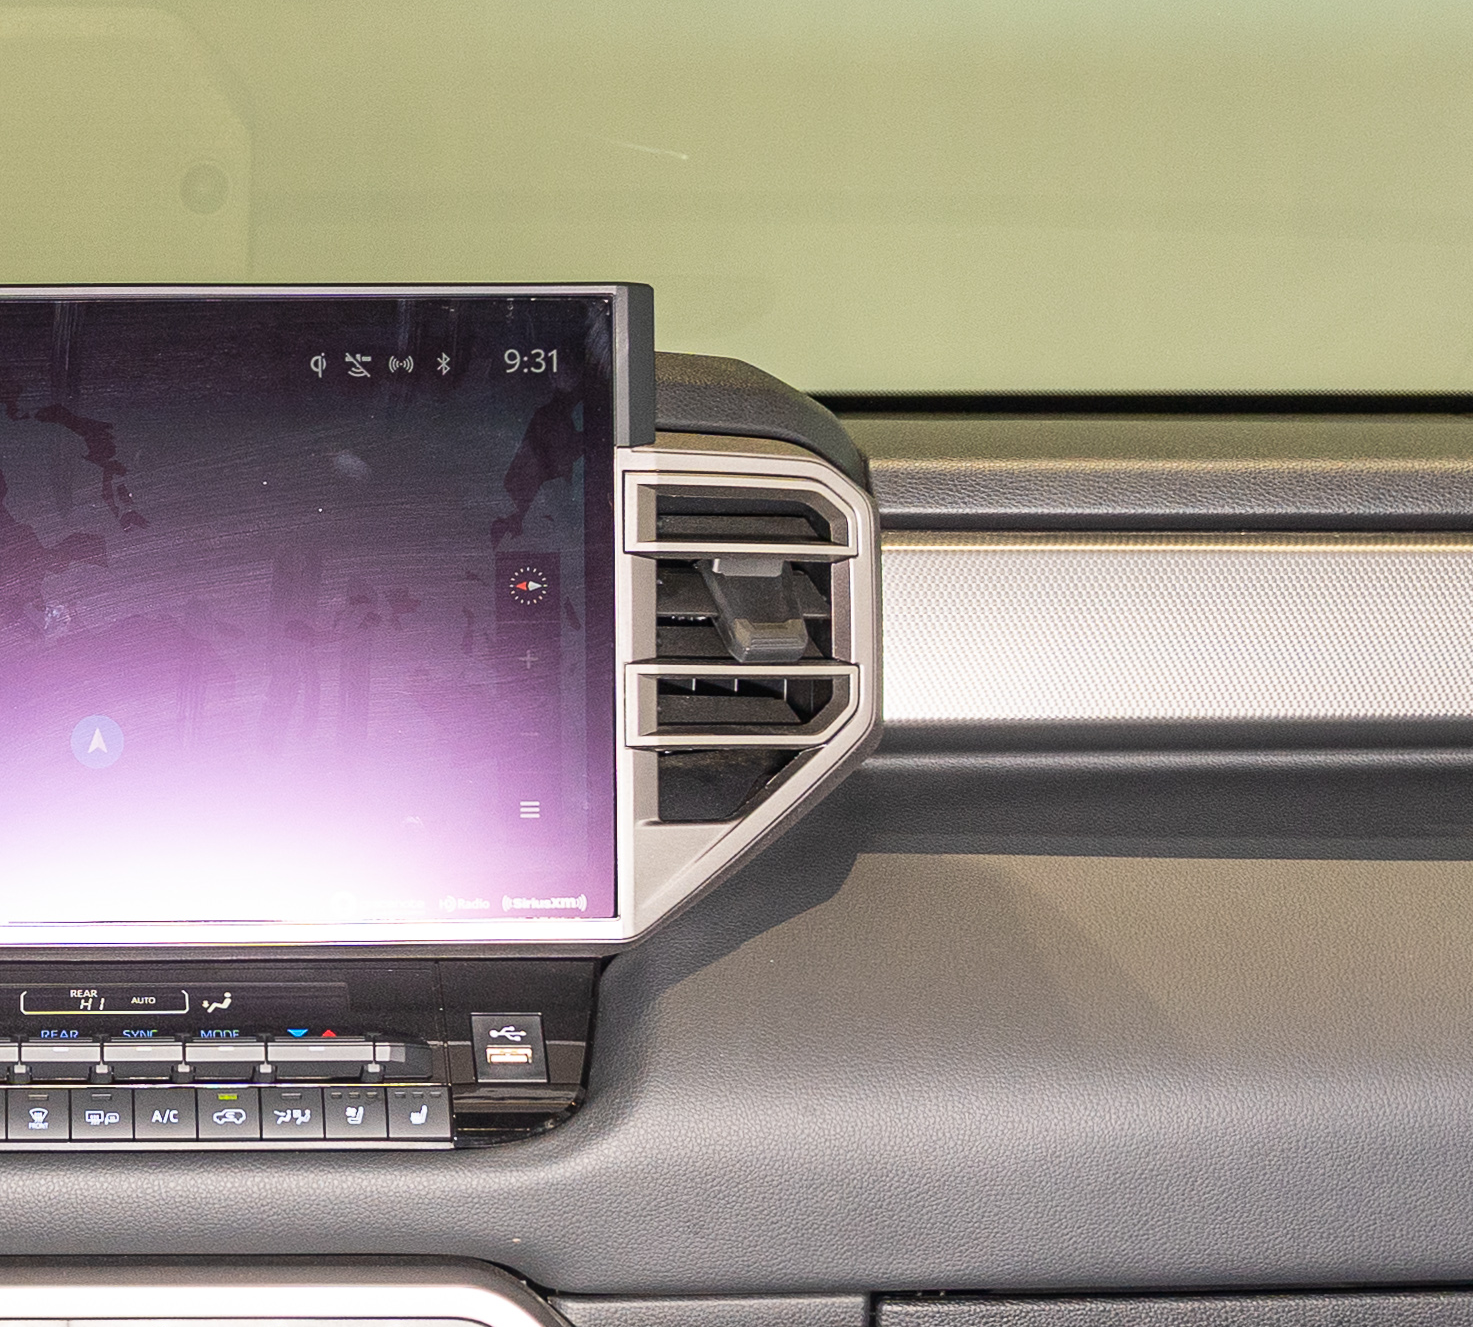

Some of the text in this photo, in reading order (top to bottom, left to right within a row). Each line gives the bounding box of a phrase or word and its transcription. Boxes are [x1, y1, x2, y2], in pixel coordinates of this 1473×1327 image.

[504, 348, 558, 373] 9:31
[457, 899, 490, 910] Radio
[70, 989, 98, 998] REAR
[131, 996, 156, 1005] AUTO
[151, 1110, 179, 1123] A/C
